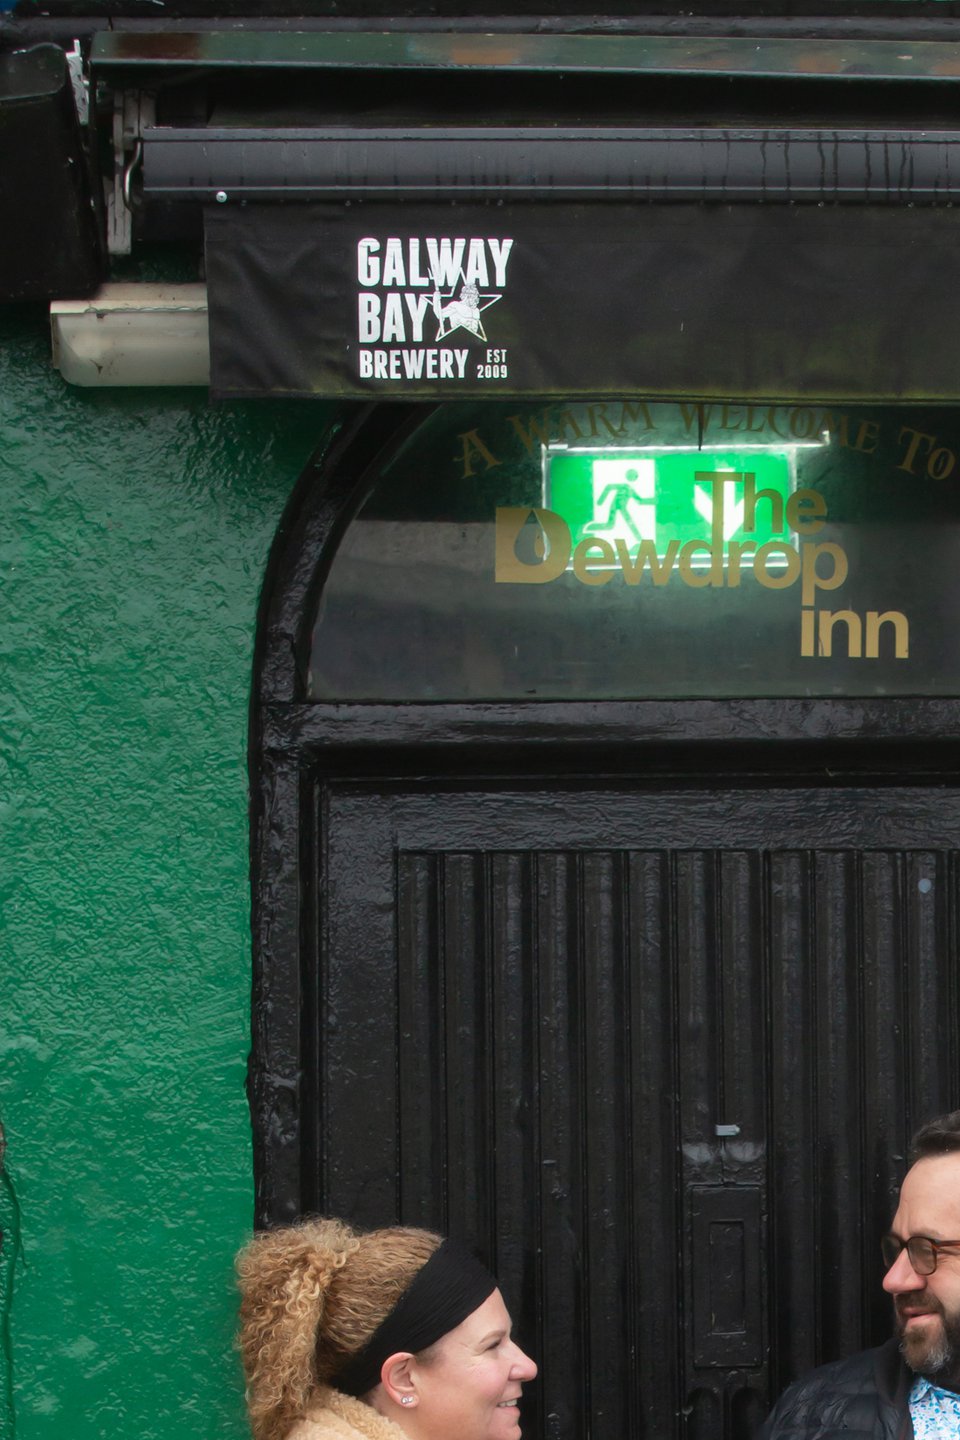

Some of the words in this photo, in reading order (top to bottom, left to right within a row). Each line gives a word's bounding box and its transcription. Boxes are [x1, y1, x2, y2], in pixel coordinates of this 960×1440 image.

[357, 237, 514, 287] GALWAY
[358, 292, 429, 344] BAY
[359, 349, 469, 380] BREWERY
[476, 364, 508, 379] 2009
[486, 349, 507, 364] EST
[453, 428, 503, 479] A
[506, 401, 658, 454] WARM
[678, 401, 882, 453] WELCOME
[896, 425, 956, 481] TO
[694, 470, 828, 535] The
[494, 506, 849, 606] Dewdrop
